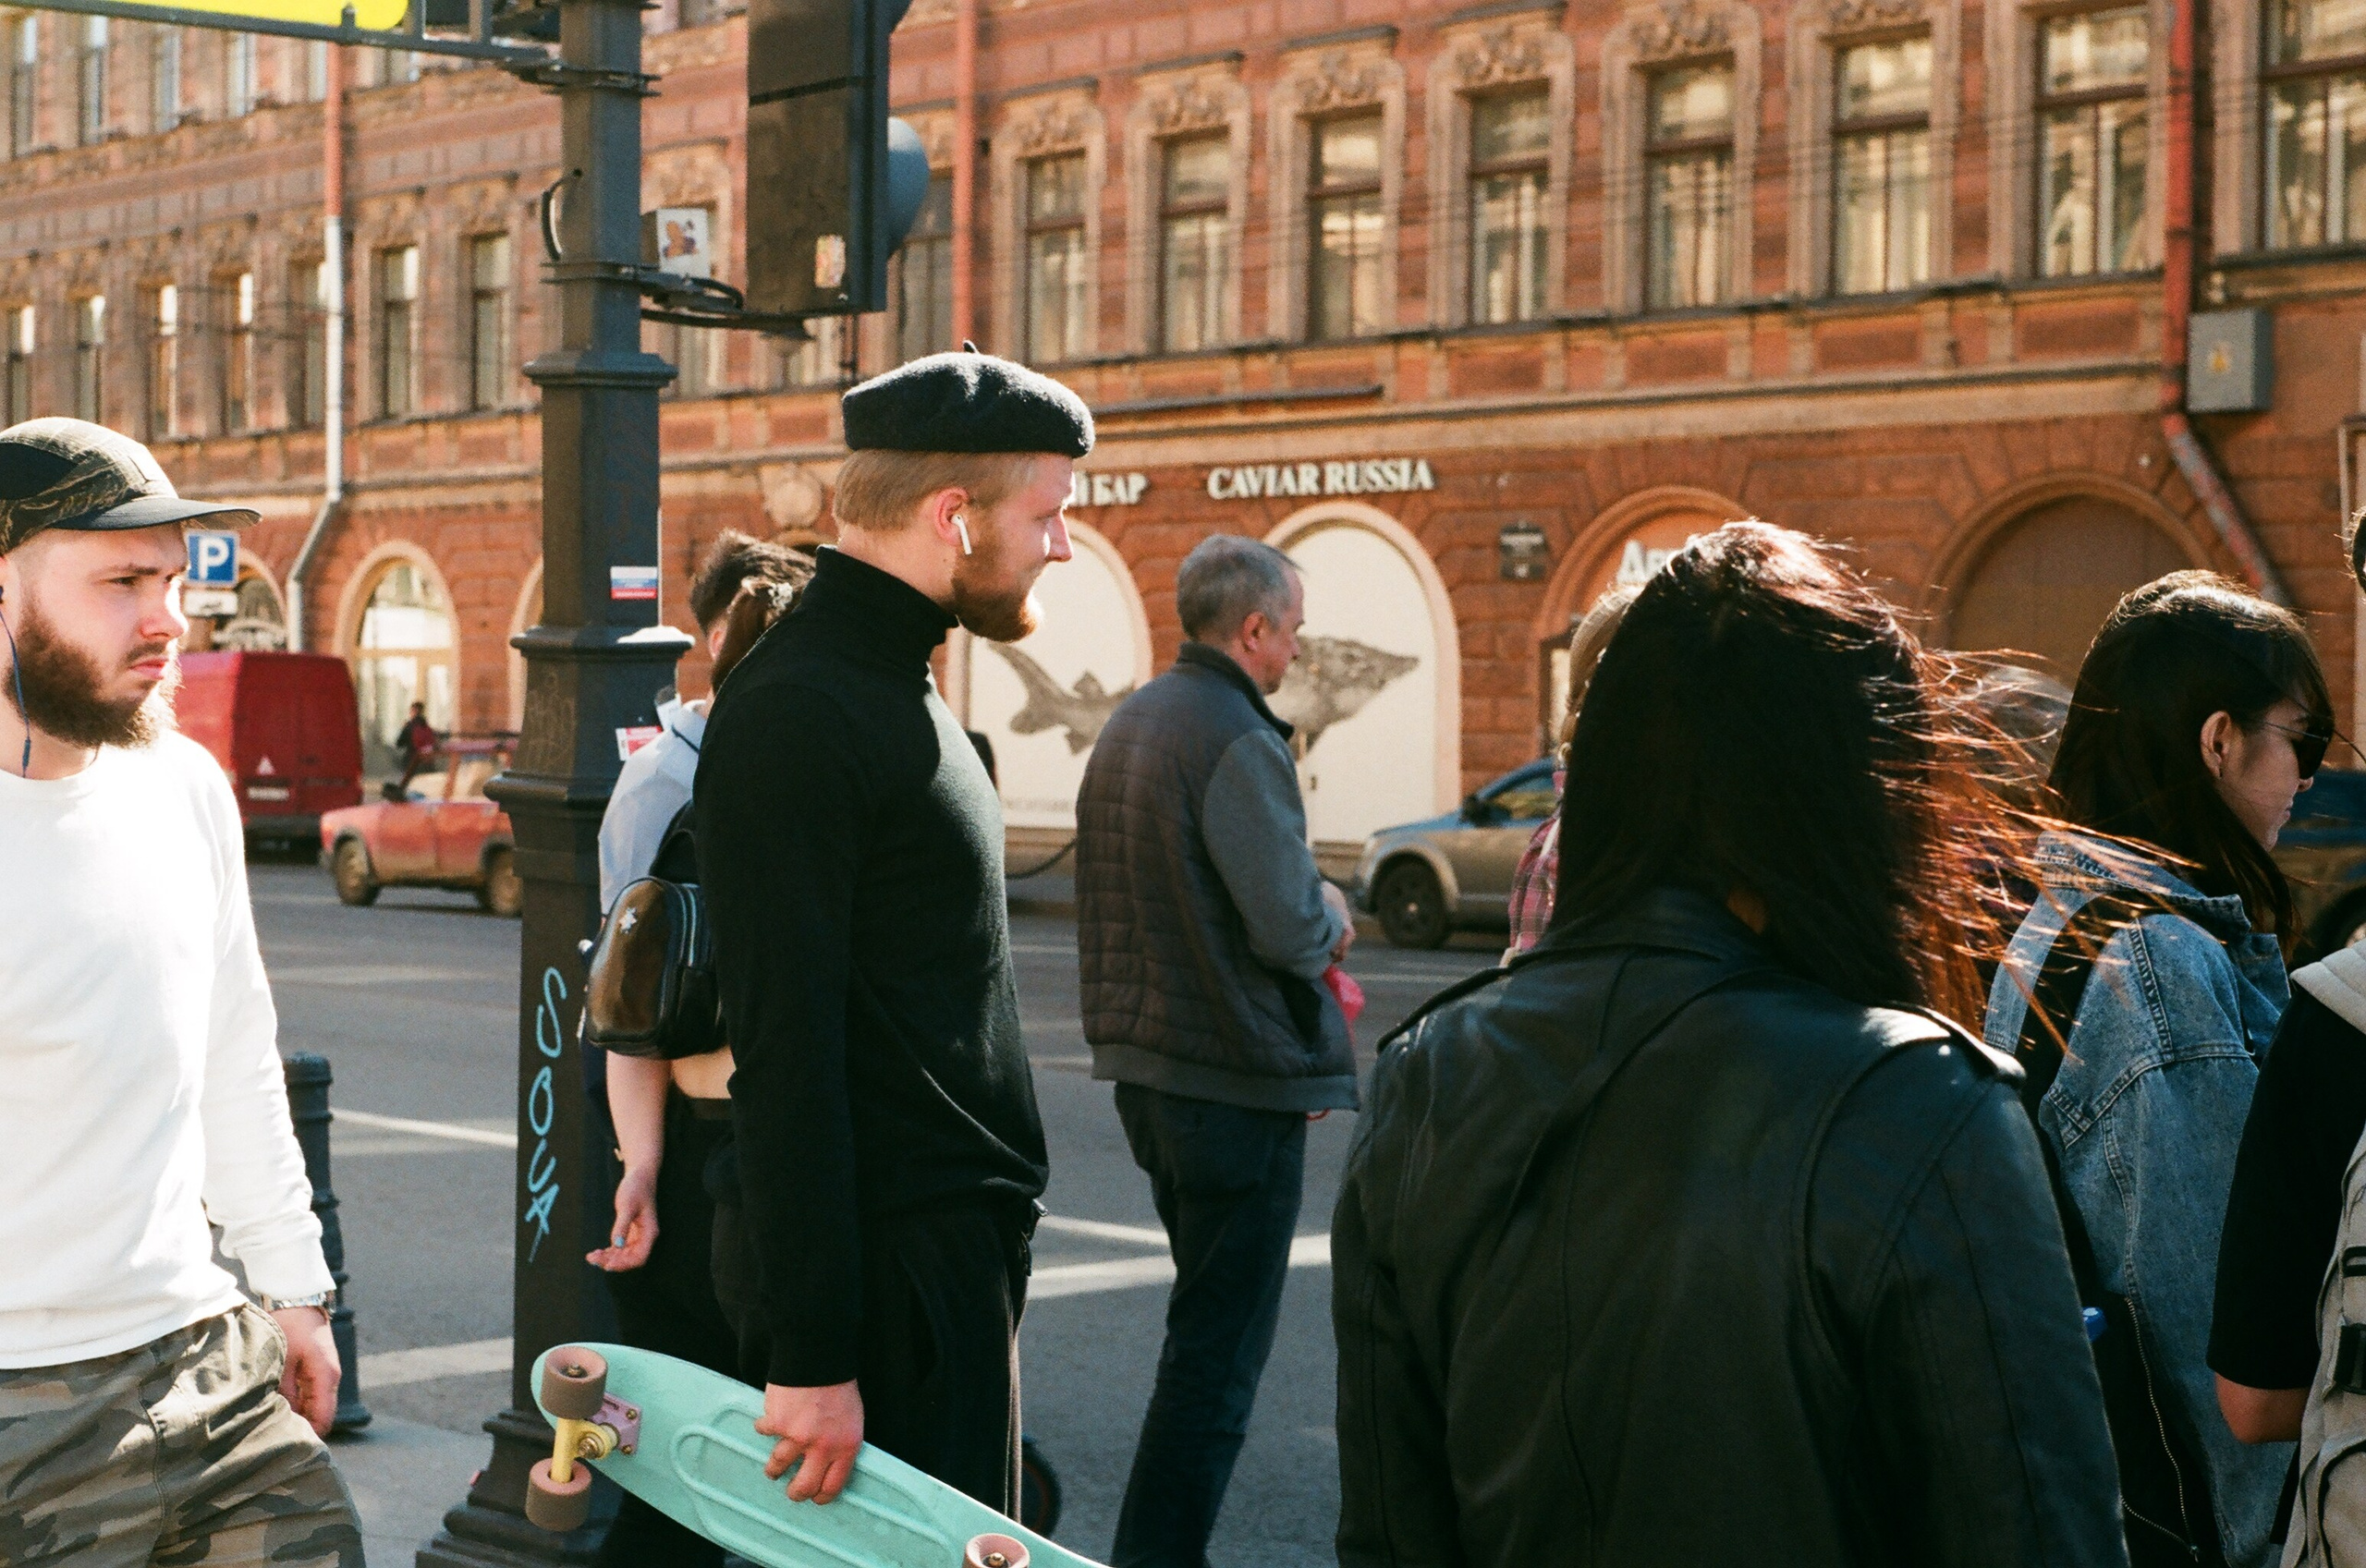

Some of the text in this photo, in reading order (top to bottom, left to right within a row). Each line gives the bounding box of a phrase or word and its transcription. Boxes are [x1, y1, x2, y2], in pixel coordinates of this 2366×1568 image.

[1092, 472, 1147, 506] БАР
[1207, 459, 1434, 500] CAVIAR RUSSIA
[198, 536, 230, 580] P
